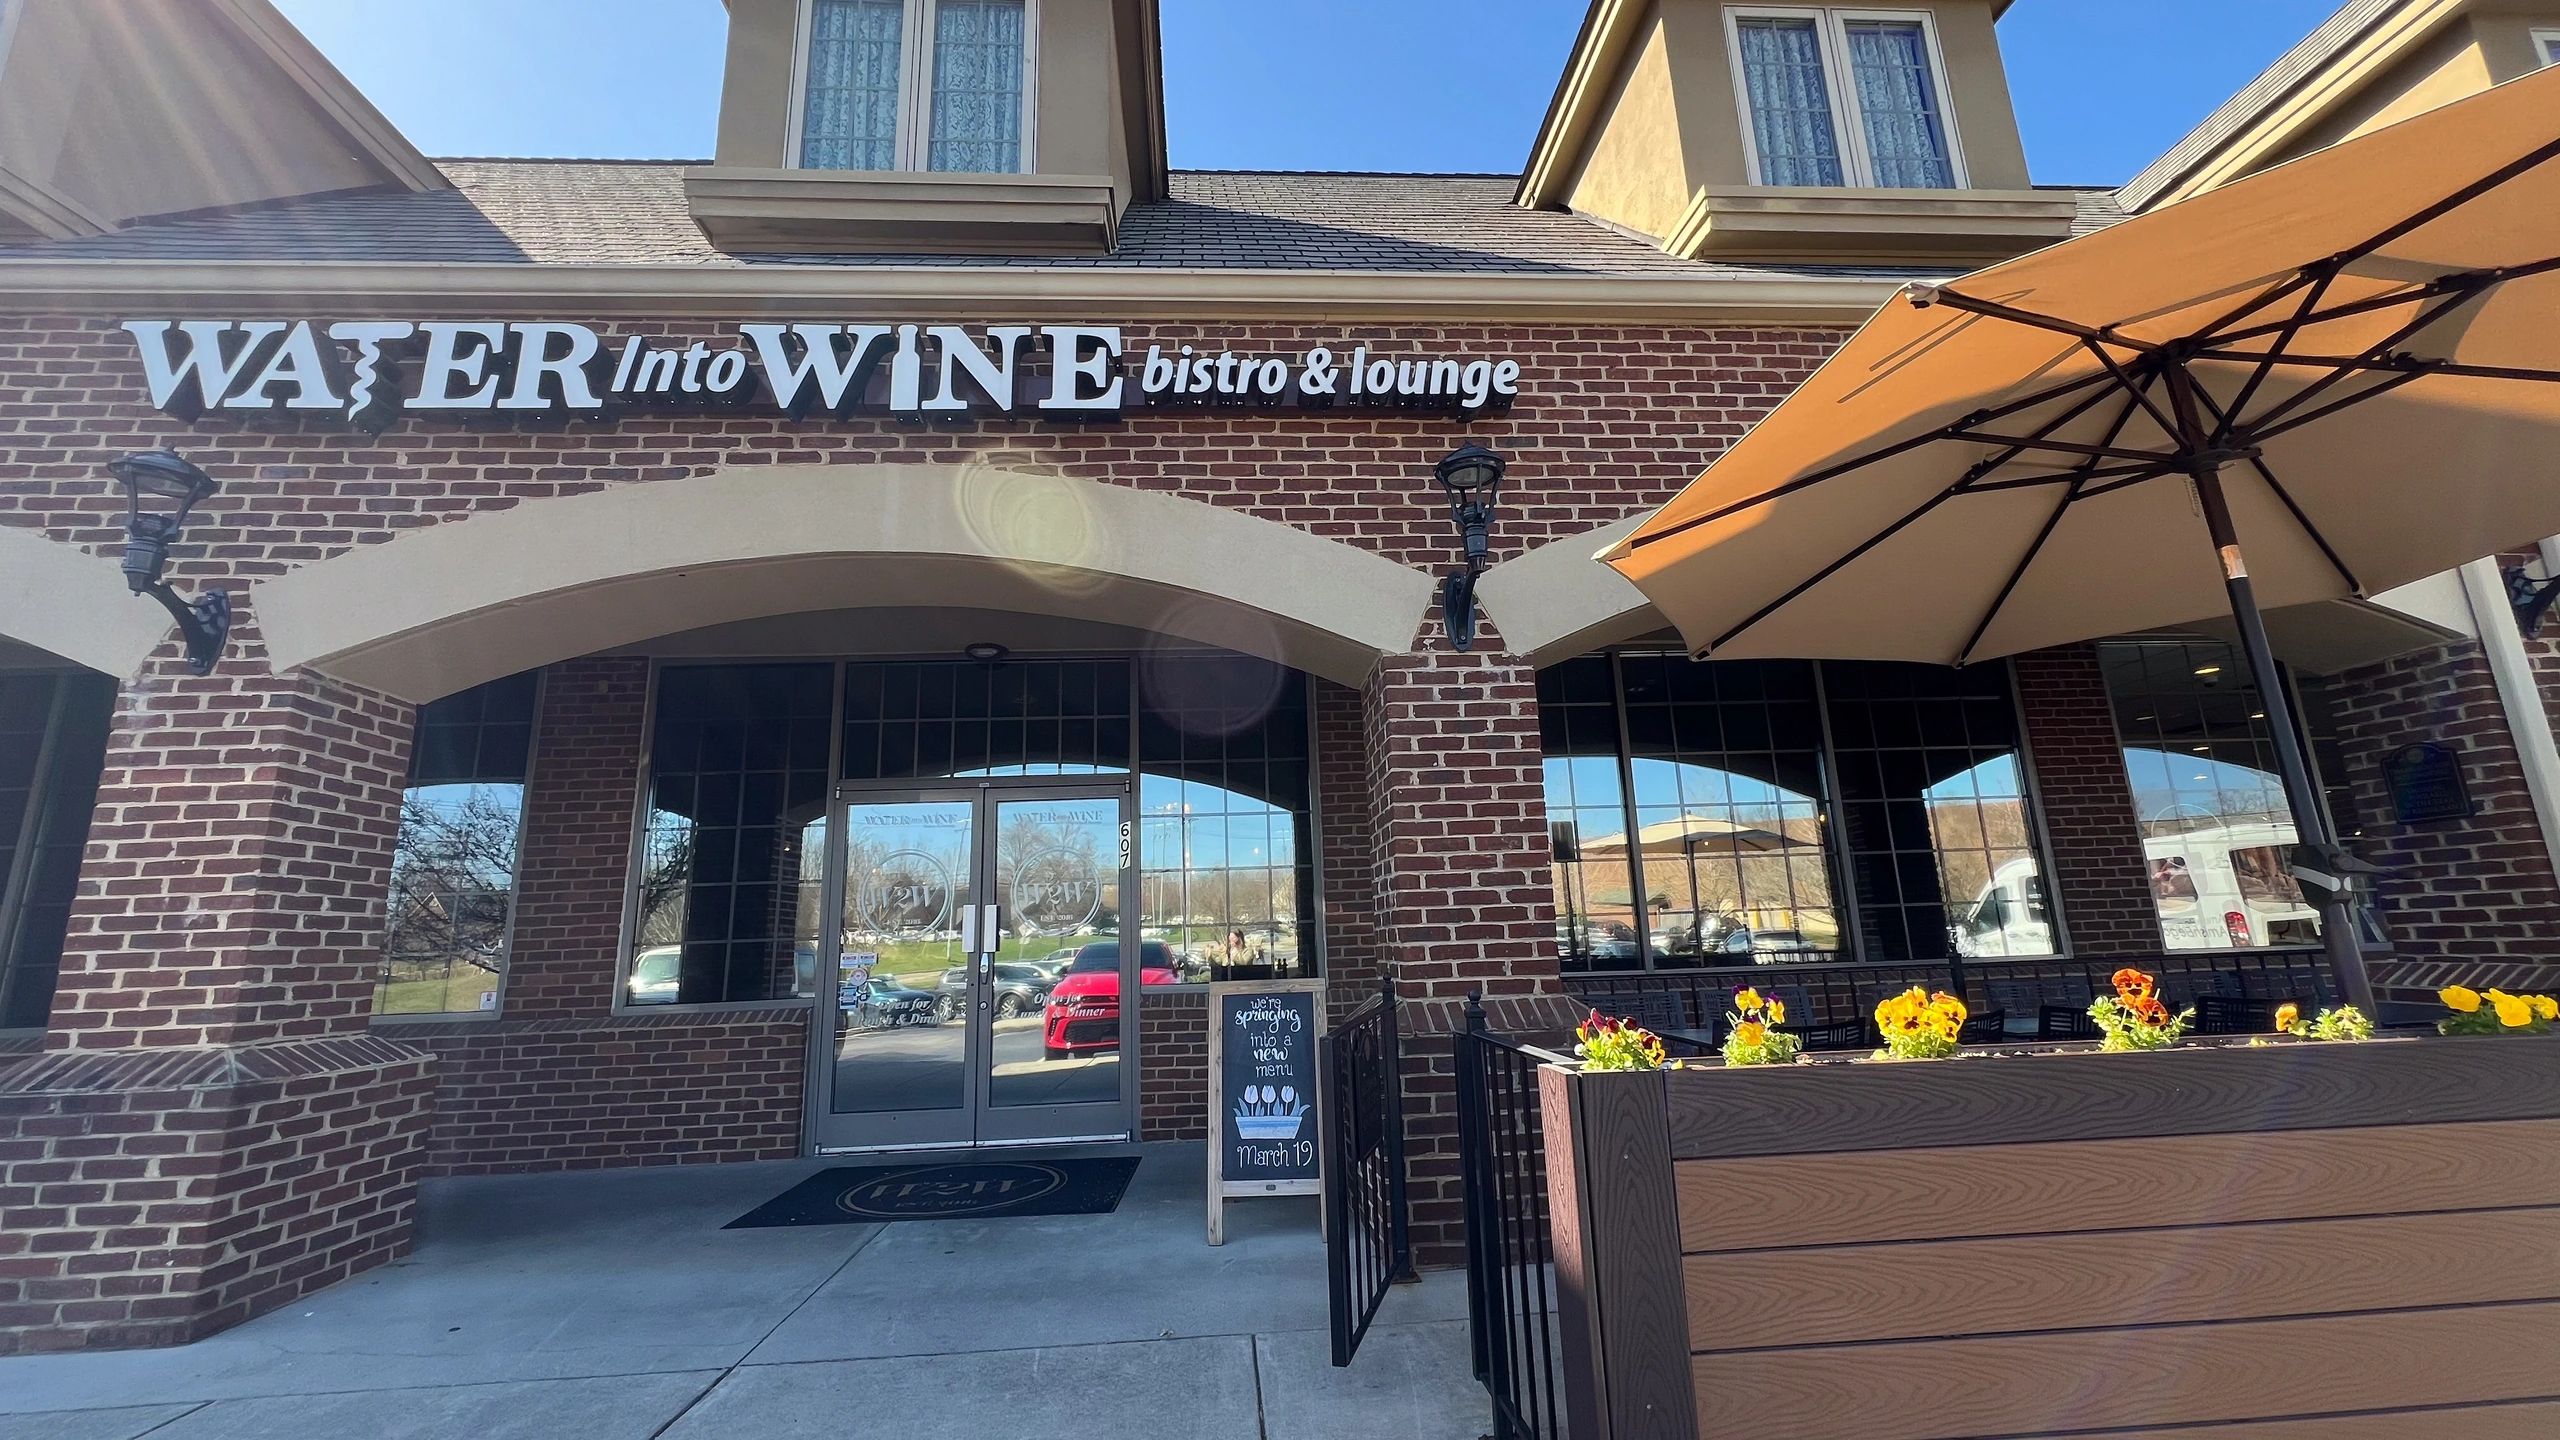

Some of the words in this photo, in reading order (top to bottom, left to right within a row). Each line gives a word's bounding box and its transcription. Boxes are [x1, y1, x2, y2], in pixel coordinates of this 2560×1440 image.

[121, 320, 603, 422] WATER
[611, 334, 747, 395] Into
[740, 323, 1123, 411] WINE
[1142, 344, 1288, 396] bistro
[1299, 346, 1339, 395] &
[1350, 346, 1520, 410] lounge
[1120, 823, 1130, 868] 607
[866, 884, 940, 909] W2W
[1021, 881, 1095, 905] W2W
[910, 998, 931, 1011] for
[1250, 996, 1281, 1009] we're
[1234, 1009, 1302, 1033] springing
[1250, 1031, 1277, 1047] into
[1283, 1034, 1293, 1046] a
[1253, 1047, 1288, 1061] new
[1255, 1064, 1294, 1078] menu
[1236, 1142, 1290, 1168] March
[1293, 1140, 1313, 1167] 19
